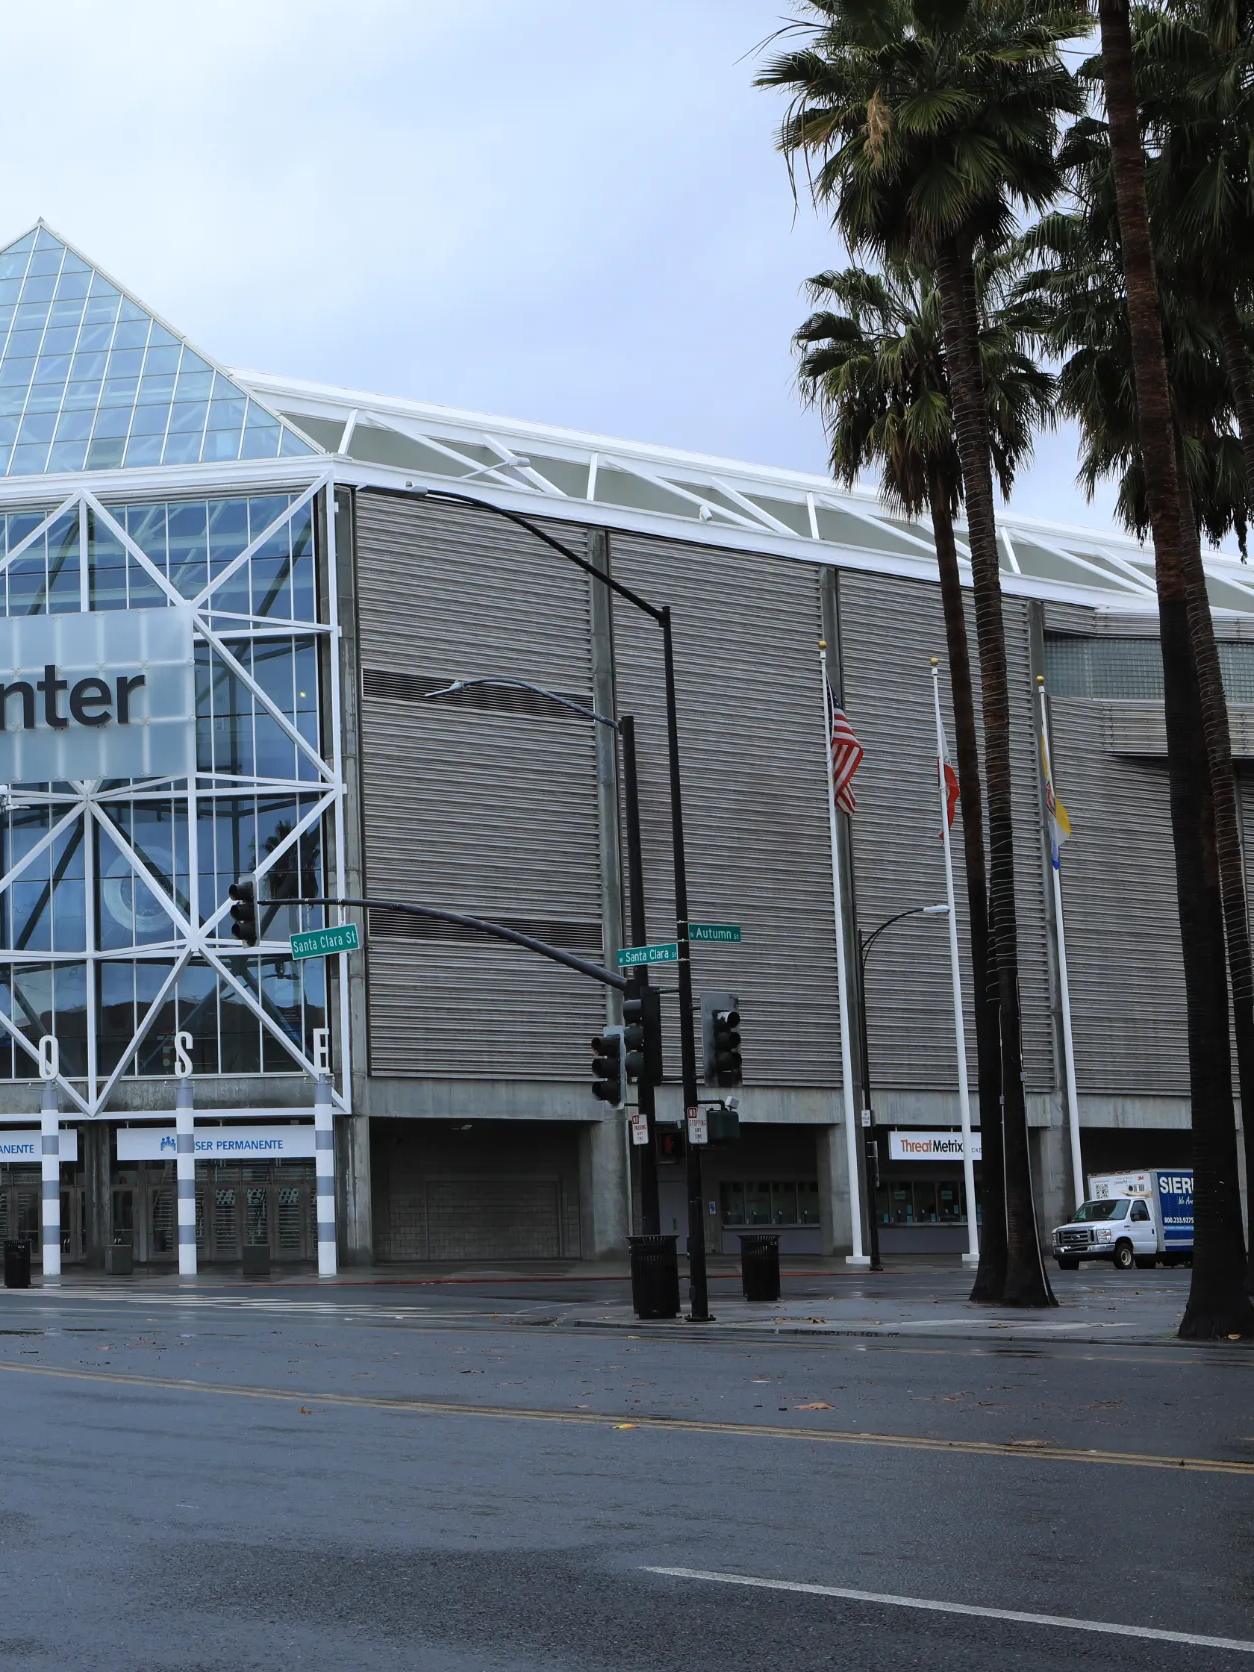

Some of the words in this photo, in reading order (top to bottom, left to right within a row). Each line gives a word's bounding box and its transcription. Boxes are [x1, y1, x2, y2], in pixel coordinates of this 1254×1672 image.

[695, 927, 732, 940] Autumn
[293, 938, 318, 953] Santa
[319, 935, 344, 948] Clara
[345, 930, 356, 944] St
[625, 950, 647, 963] Santa
[649, 949, 669, 960] Clara
[216, 1139, 284, 1150] PERMANENTE
[900, 1139, 964, 1153] ThreatMetrix
